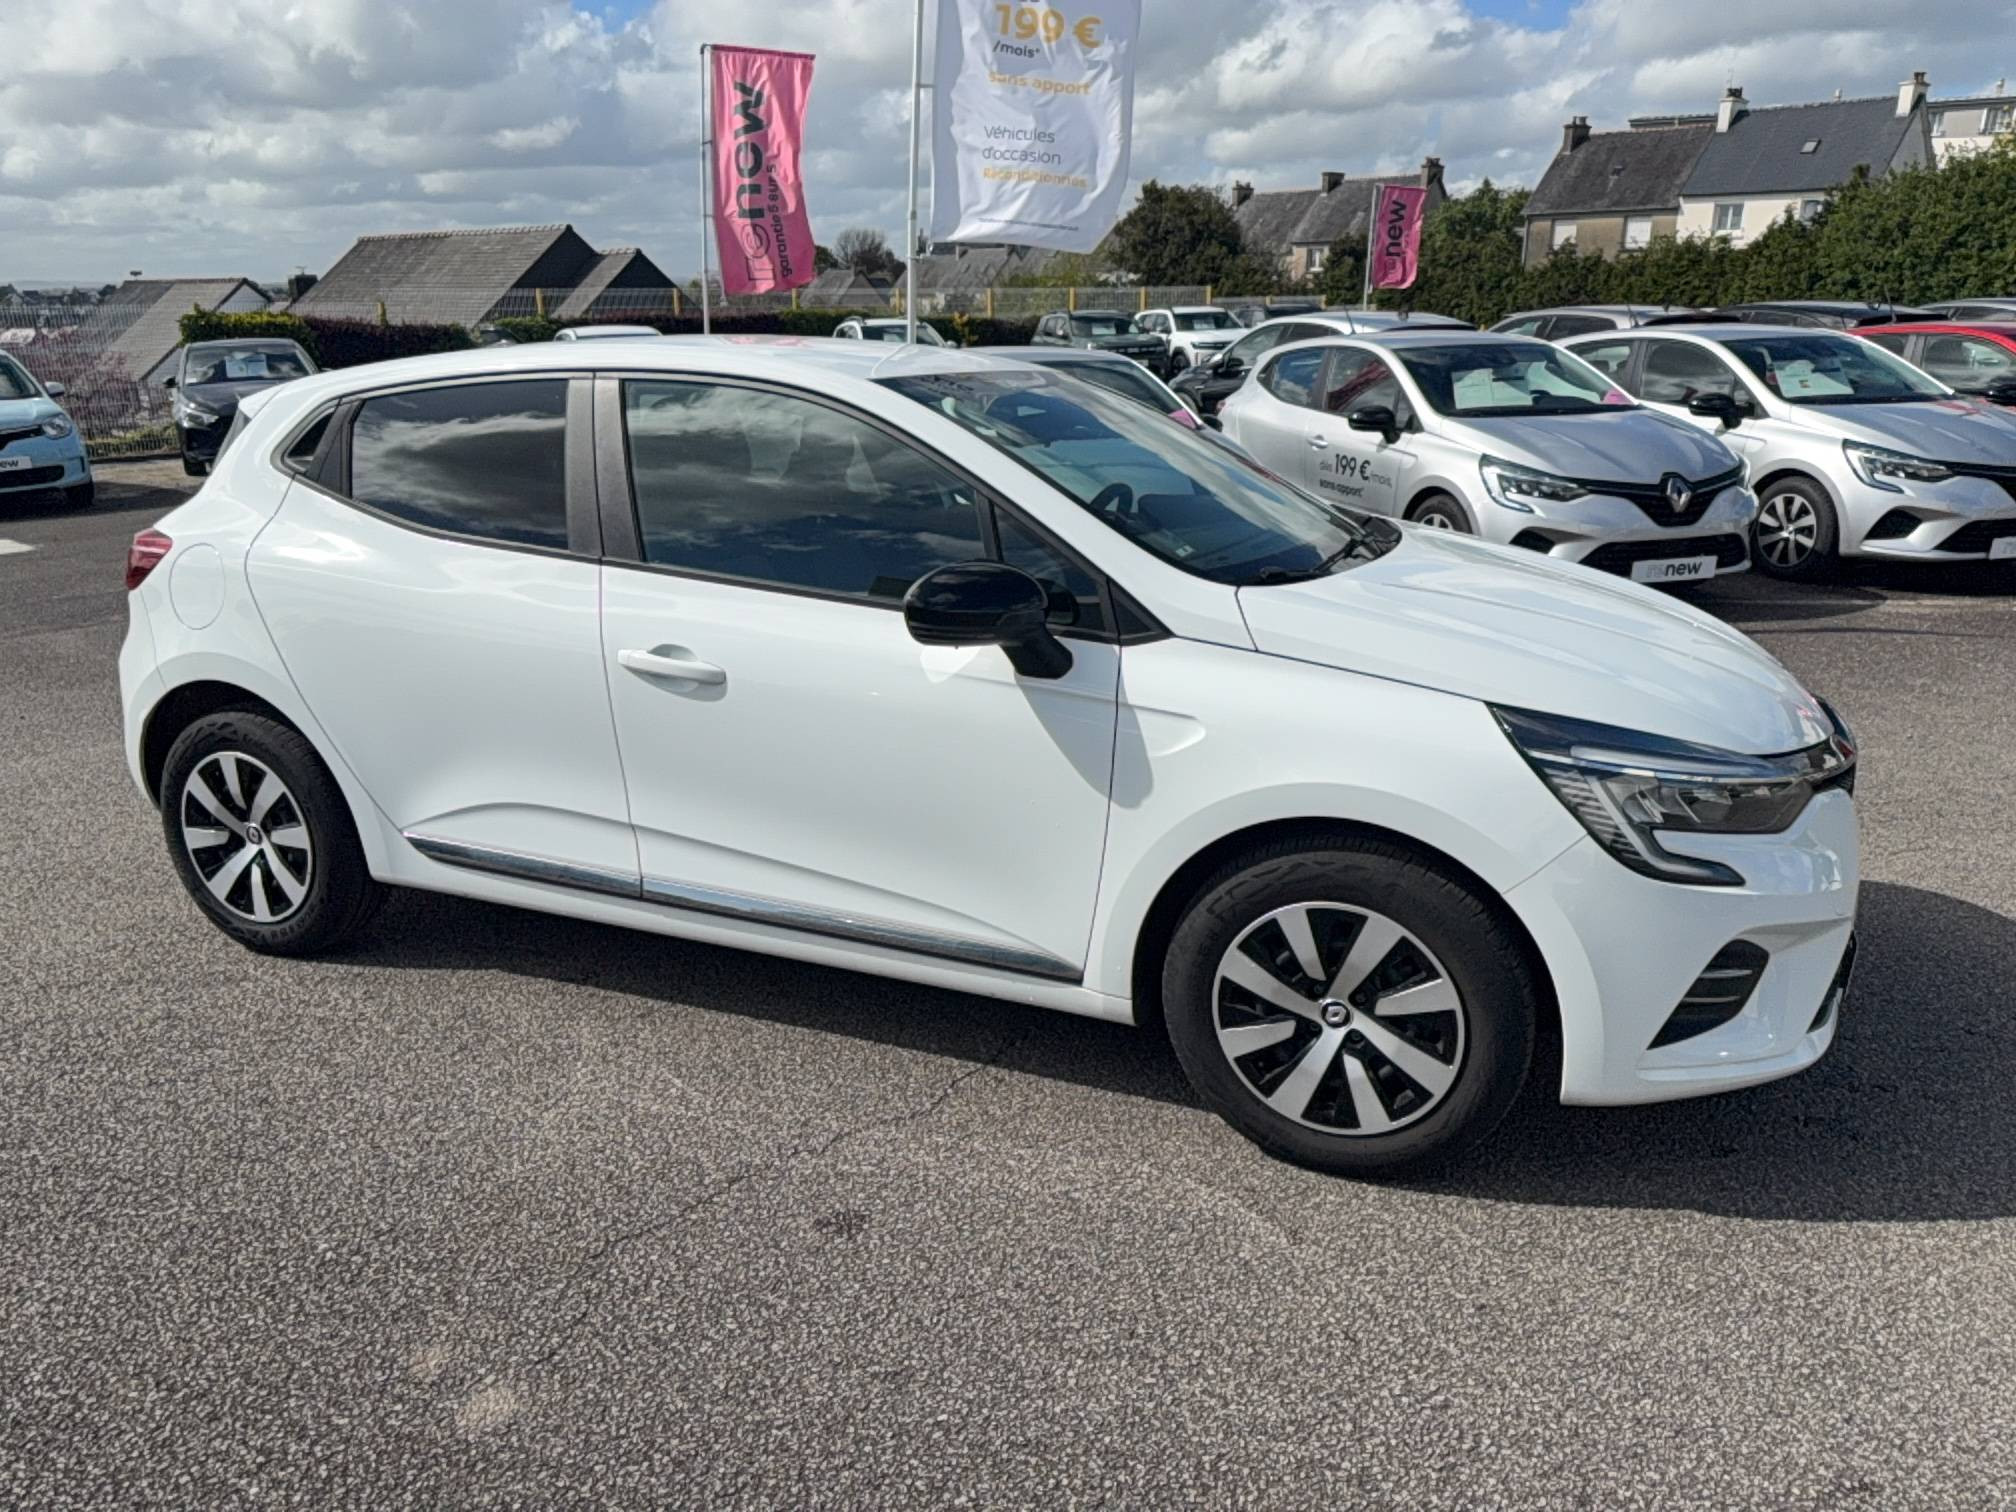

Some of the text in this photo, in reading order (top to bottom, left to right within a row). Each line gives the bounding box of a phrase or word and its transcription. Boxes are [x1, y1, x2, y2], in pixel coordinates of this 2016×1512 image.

[994, 4, 1104, 48] 199 €
[989, 72, 1089, 95] sans apport
[984, 125, 1055, 143] Véhicules
[982, 146, 1061, 164] d'occasion
[768, 176, 780, 202] sur
[769, 216, 793, 279] garantie
[1335, 453, 1357, 477] 199
[1359, 460, 1371, 480] €
